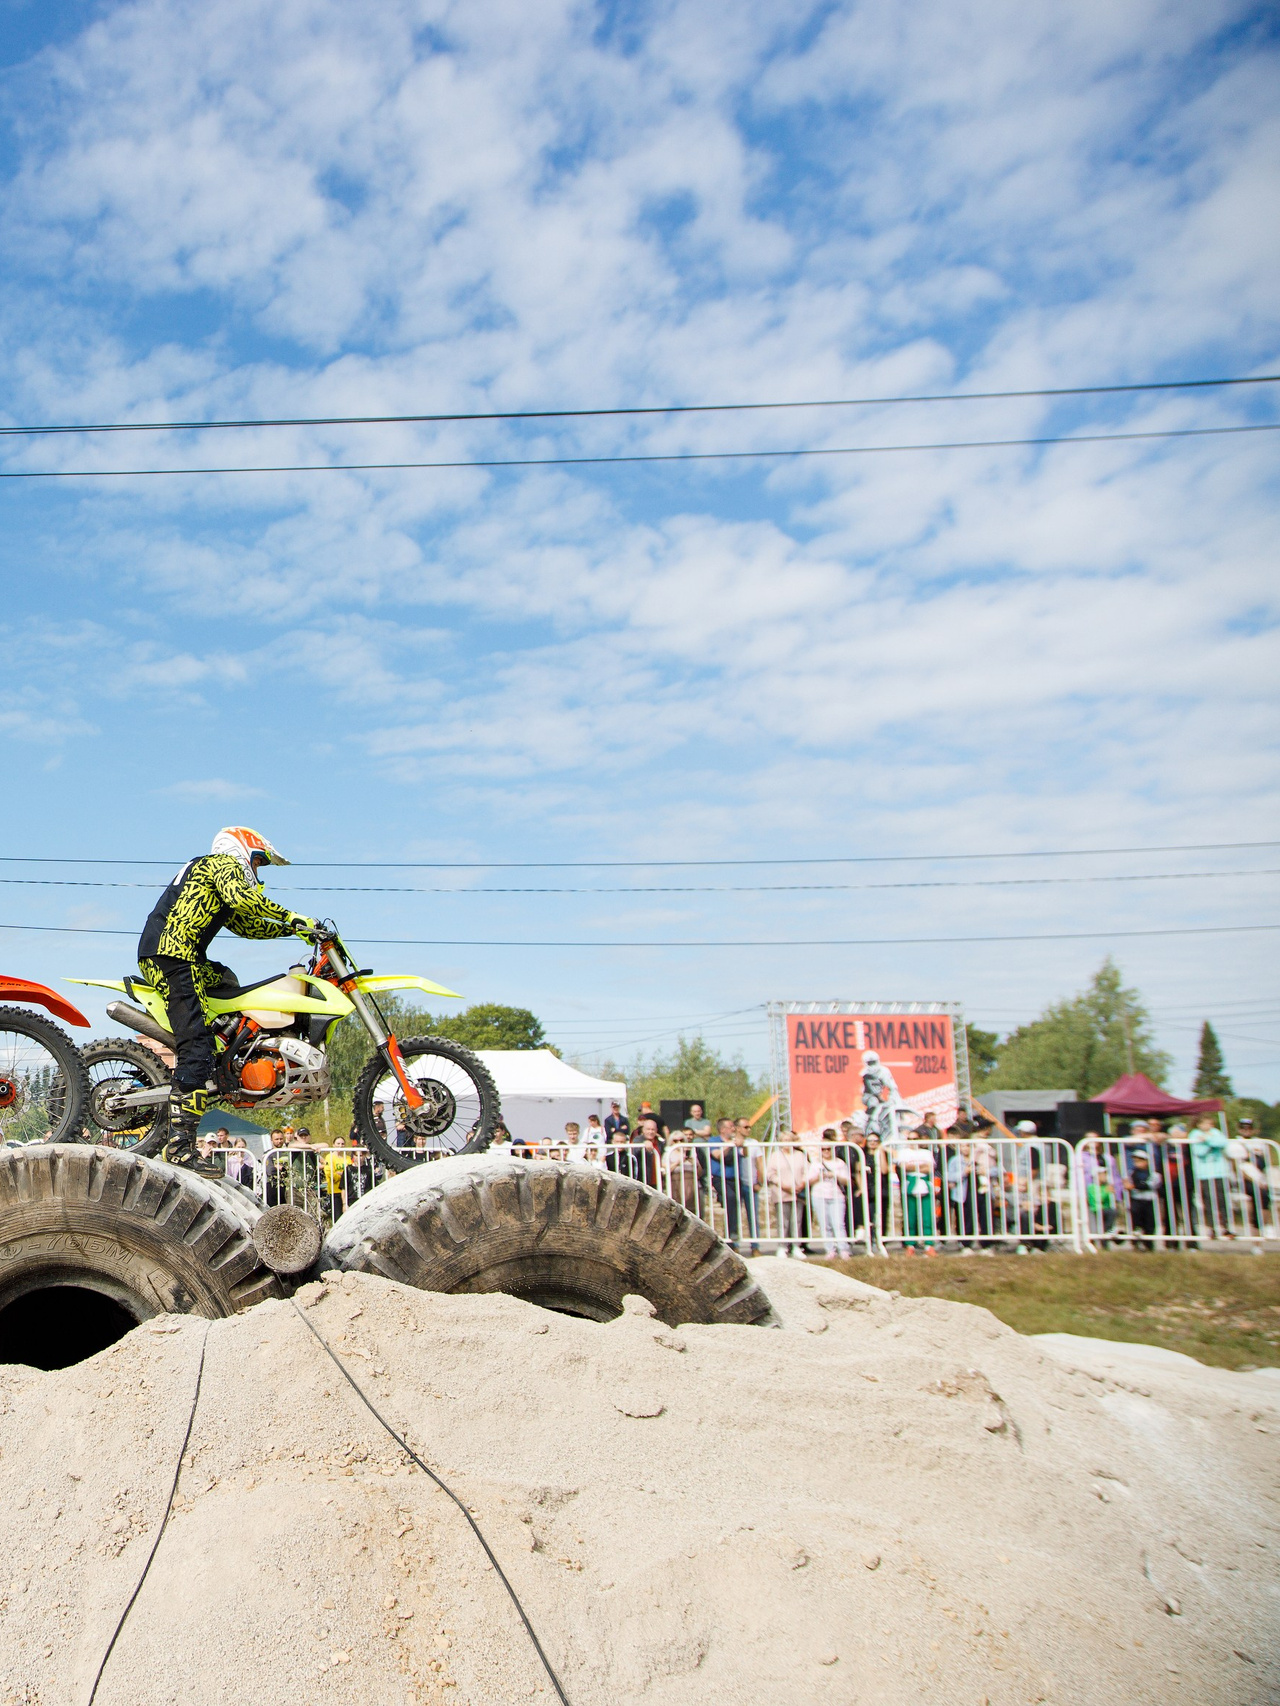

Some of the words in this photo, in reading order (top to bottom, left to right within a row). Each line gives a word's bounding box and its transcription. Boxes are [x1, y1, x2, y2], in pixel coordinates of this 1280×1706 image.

[794, 1020, 947, 1049] AKKERMANN
[794, 1054, 823, 1074] FIRE
[824, 1054, 850, 1074] CUP
[913, 1055, 948, 1075] 2024
